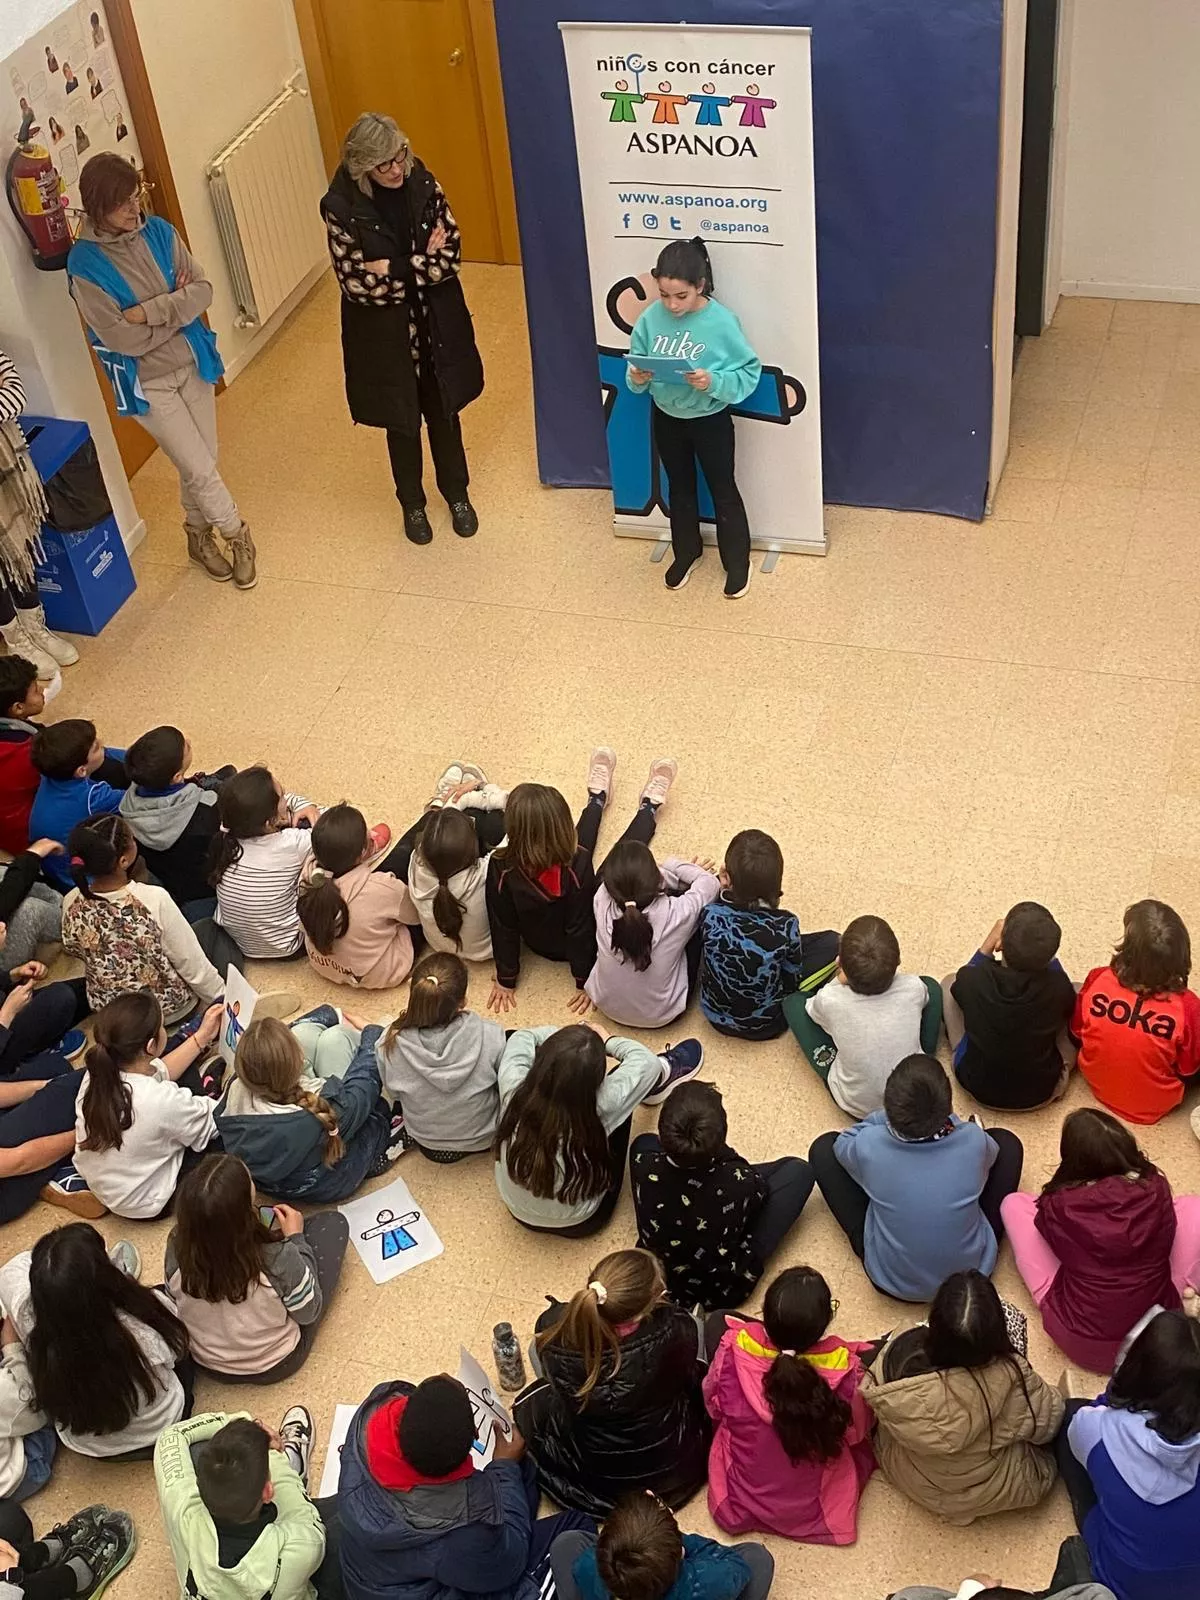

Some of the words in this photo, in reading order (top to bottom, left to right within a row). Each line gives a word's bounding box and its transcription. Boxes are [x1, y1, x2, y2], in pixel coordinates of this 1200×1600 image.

[664, 60, 700, 74] con
[707, 58, 776, 76] cáncer
[626, 131, 758, 158] ASPANOA
[618, 192, 768, 212] www.aspanoa.org
[700, 219, 769, 234] @aspanoa
[652, 331, 706, 361] nike
[1089, 990, 1176, 1041] soka
